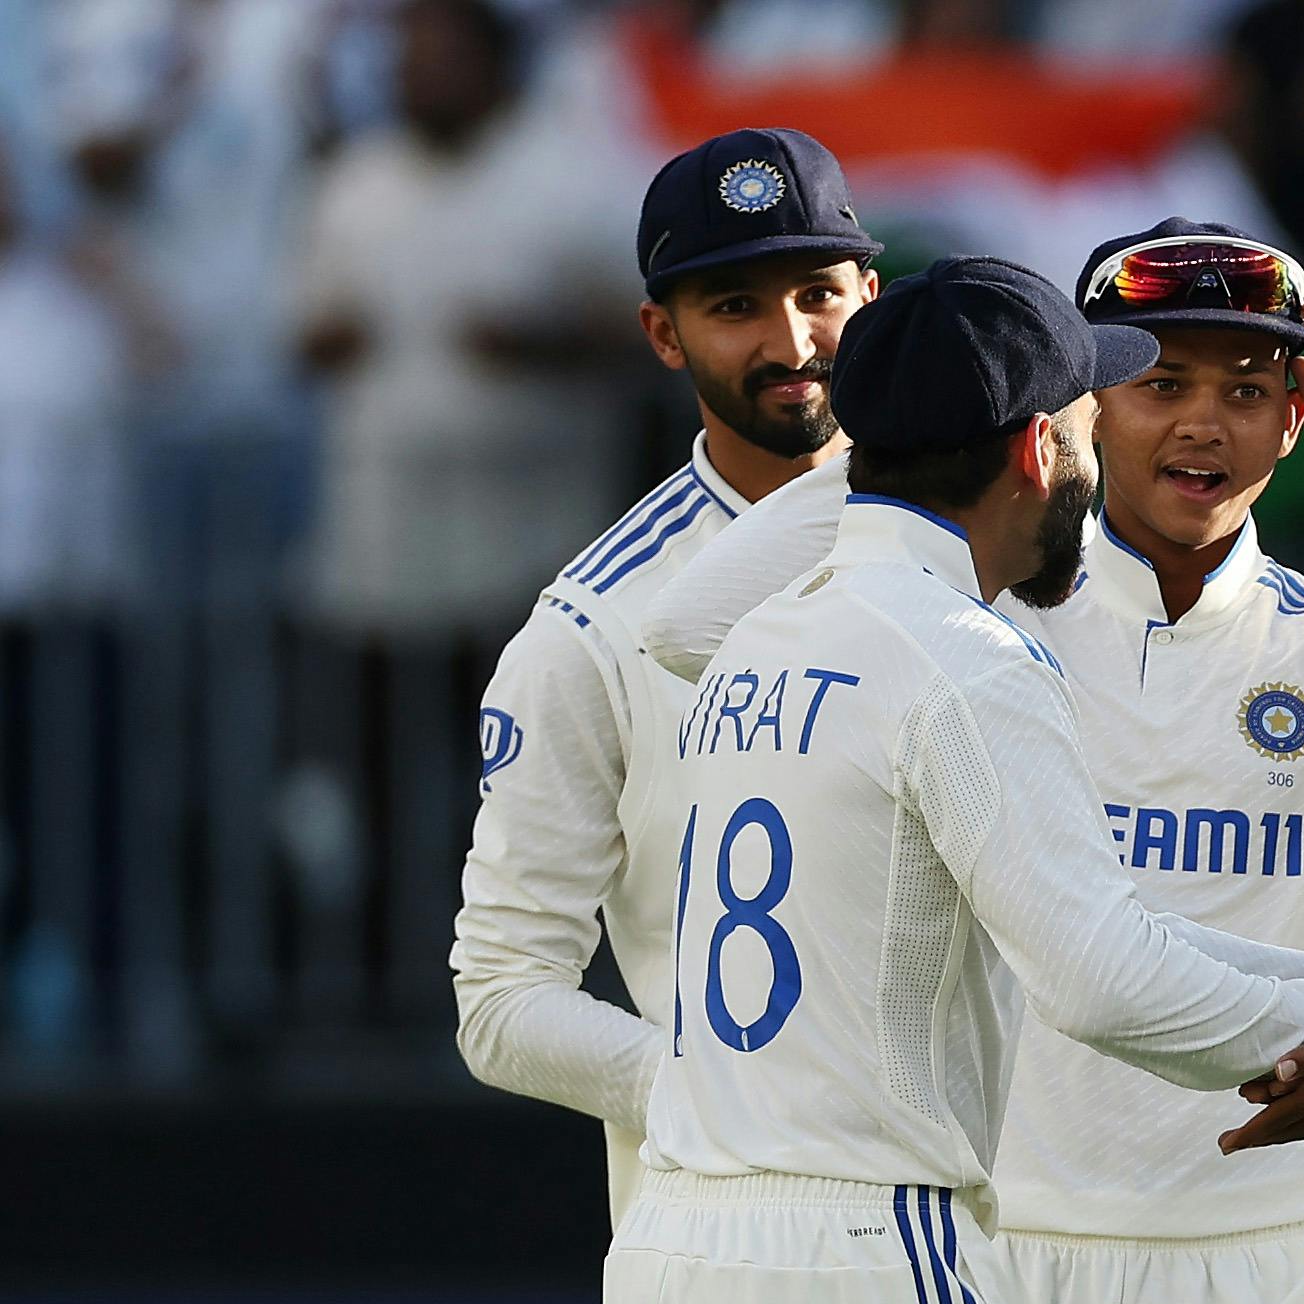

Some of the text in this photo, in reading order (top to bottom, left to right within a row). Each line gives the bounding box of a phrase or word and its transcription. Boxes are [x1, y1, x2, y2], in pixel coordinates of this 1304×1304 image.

[678, 667, 860, 761] VIRAT
[1266, 770, 1295, 788] 306
[673, 796, 803, 1059] 18
